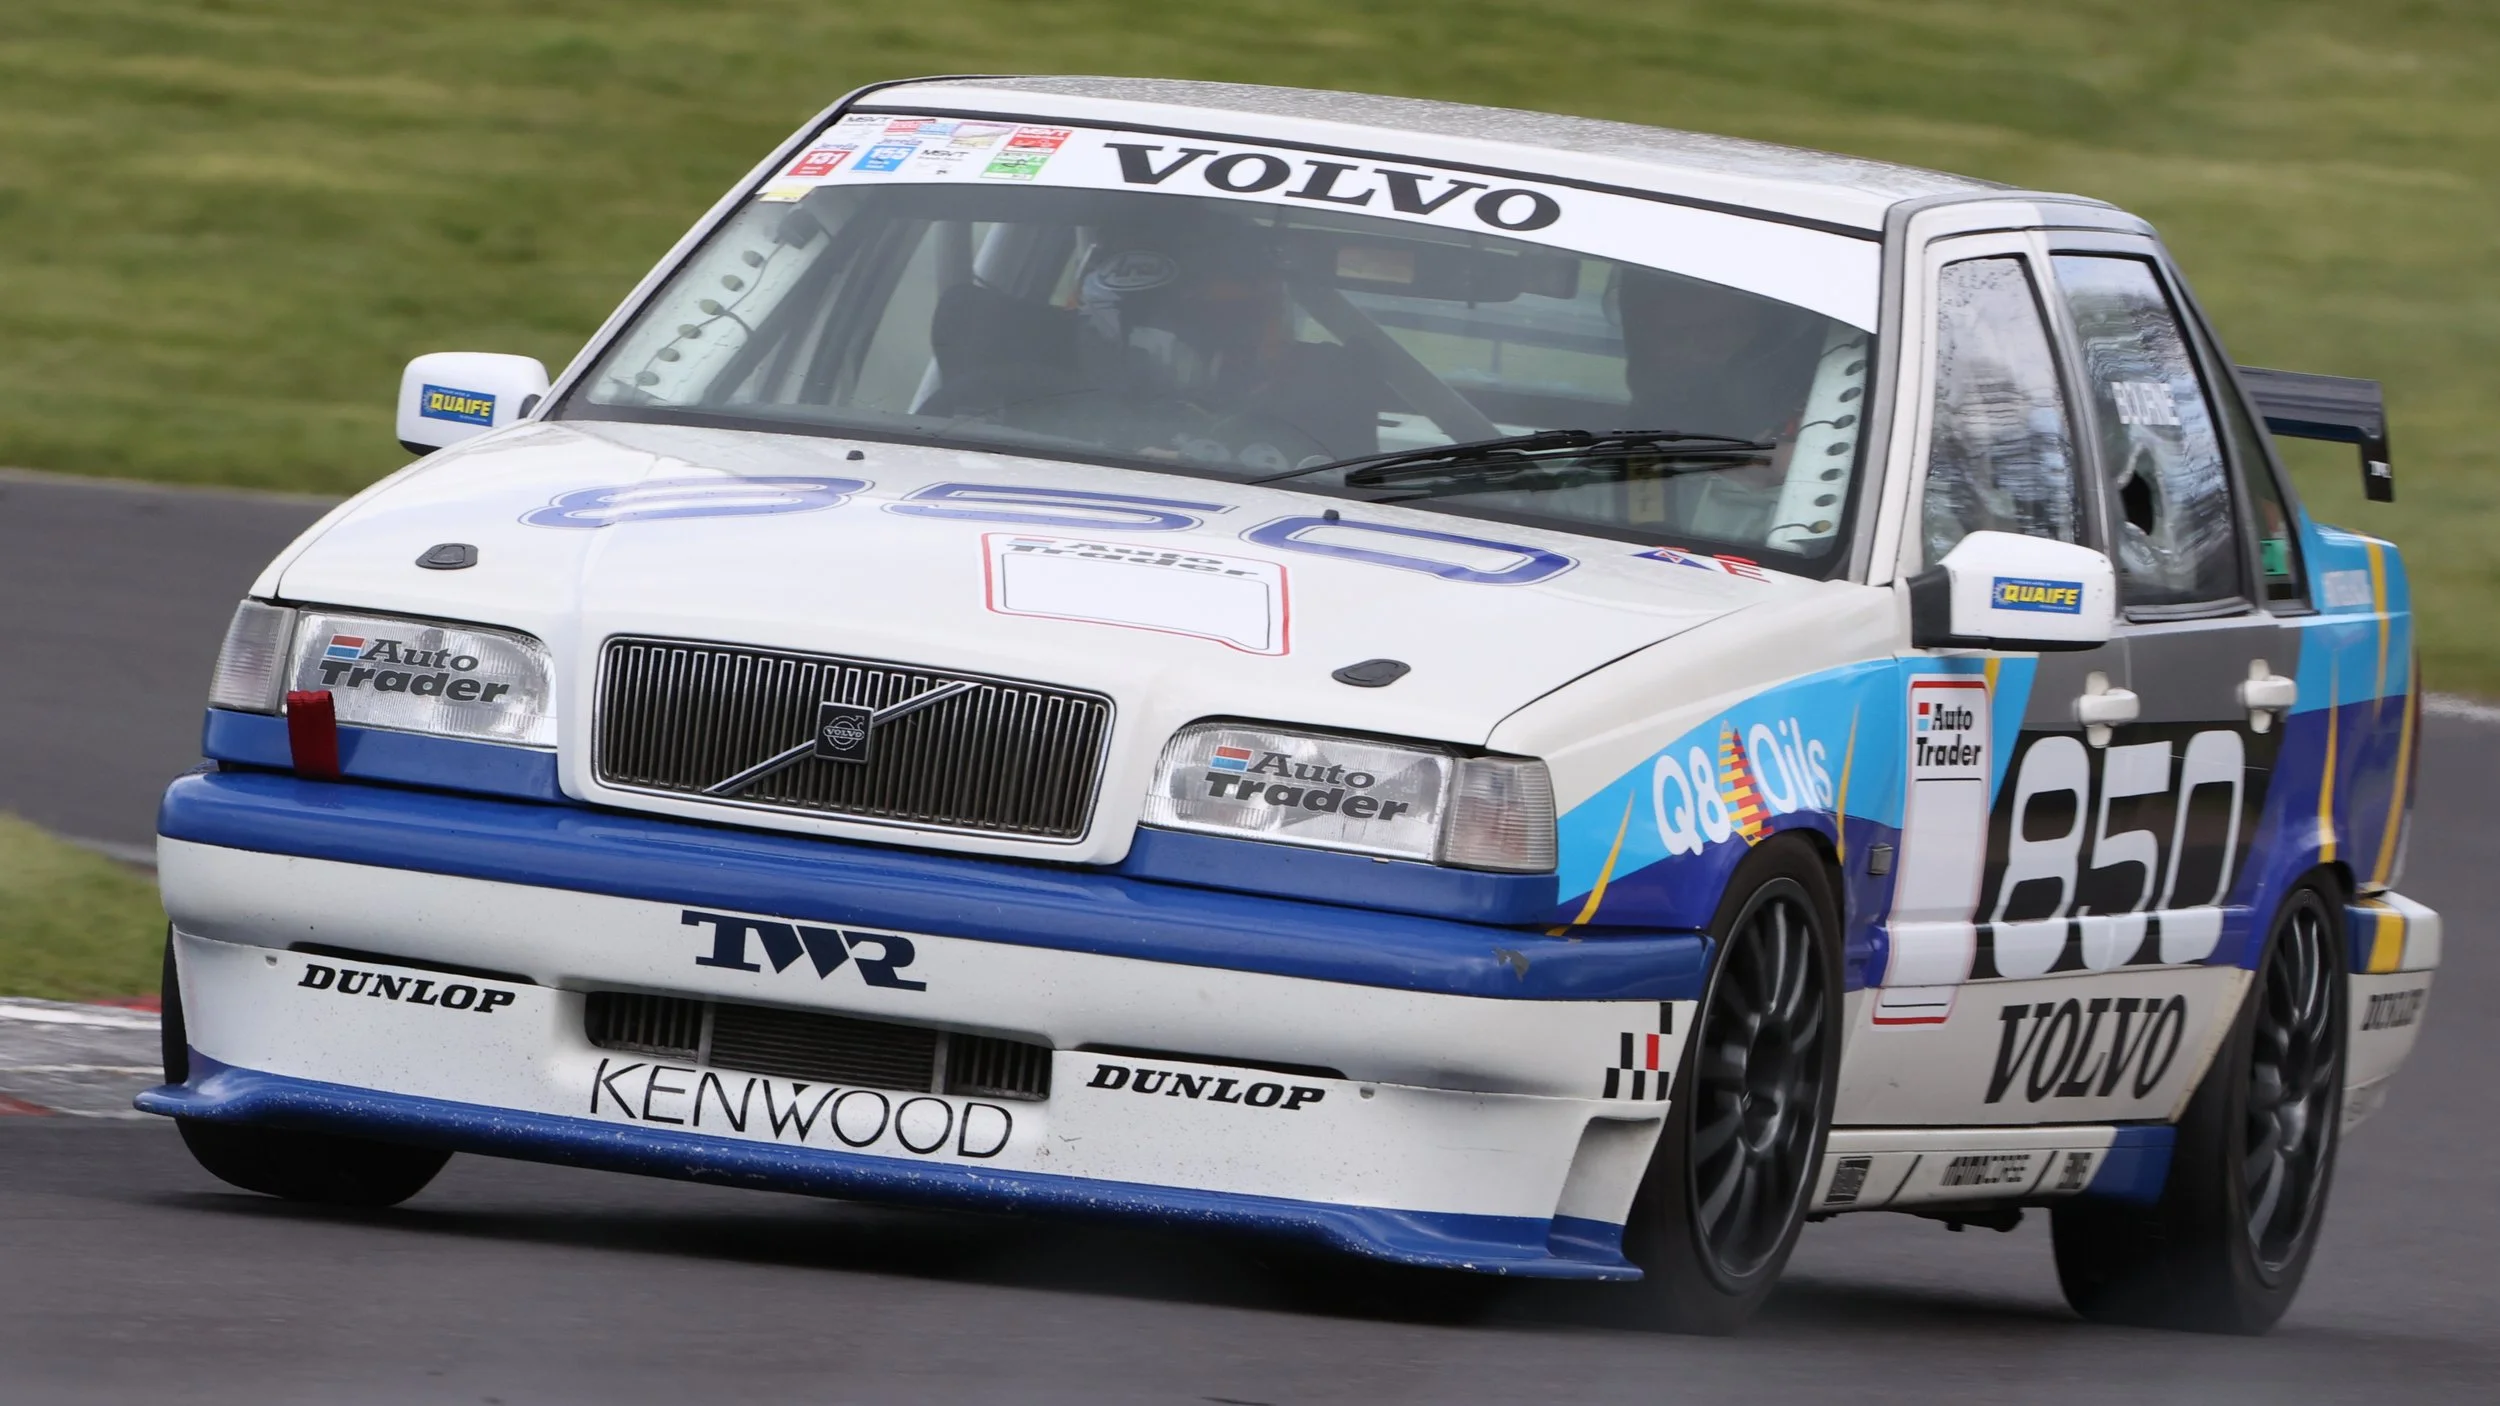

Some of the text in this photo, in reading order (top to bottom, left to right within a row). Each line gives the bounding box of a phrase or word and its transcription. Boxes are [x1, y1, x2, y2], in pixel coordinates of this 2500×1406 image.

[1104, 143, 1560, 231] VOLVO
[431, 392, 493, 417] QUAIFE
[518, 476, 1580, 586] 850
[1010, 545, 1258, 576] Trader
[1064, 543, 1224, 565] Auto
[2004, 584, 2079, 605] QUAIFE
[359, 639, 479, 672] Auto
[318, 659, 510, 703] Trader
[826, 727, 864, 739] VOLVO
[1932, 703, 1973, 730] Auto
[1247, 751, 1375, 789] Auto
[1916, 734, 1982, 766] Trader
[1204, 771, 1409, 822] Trader
[1653, 717, 1833, 855] Q8 Oils
[1990, 730, 2245, 979] 850
[681, 909, 927, 992] TWR
[298, 963, 515, 1013] DUNLOP
[1985, 994, 2187, 1104] VOLVO
[590, 1058, 1013, 1158] KENWOOD
[1086, 1064, 1326, 1110] DUNLOP
